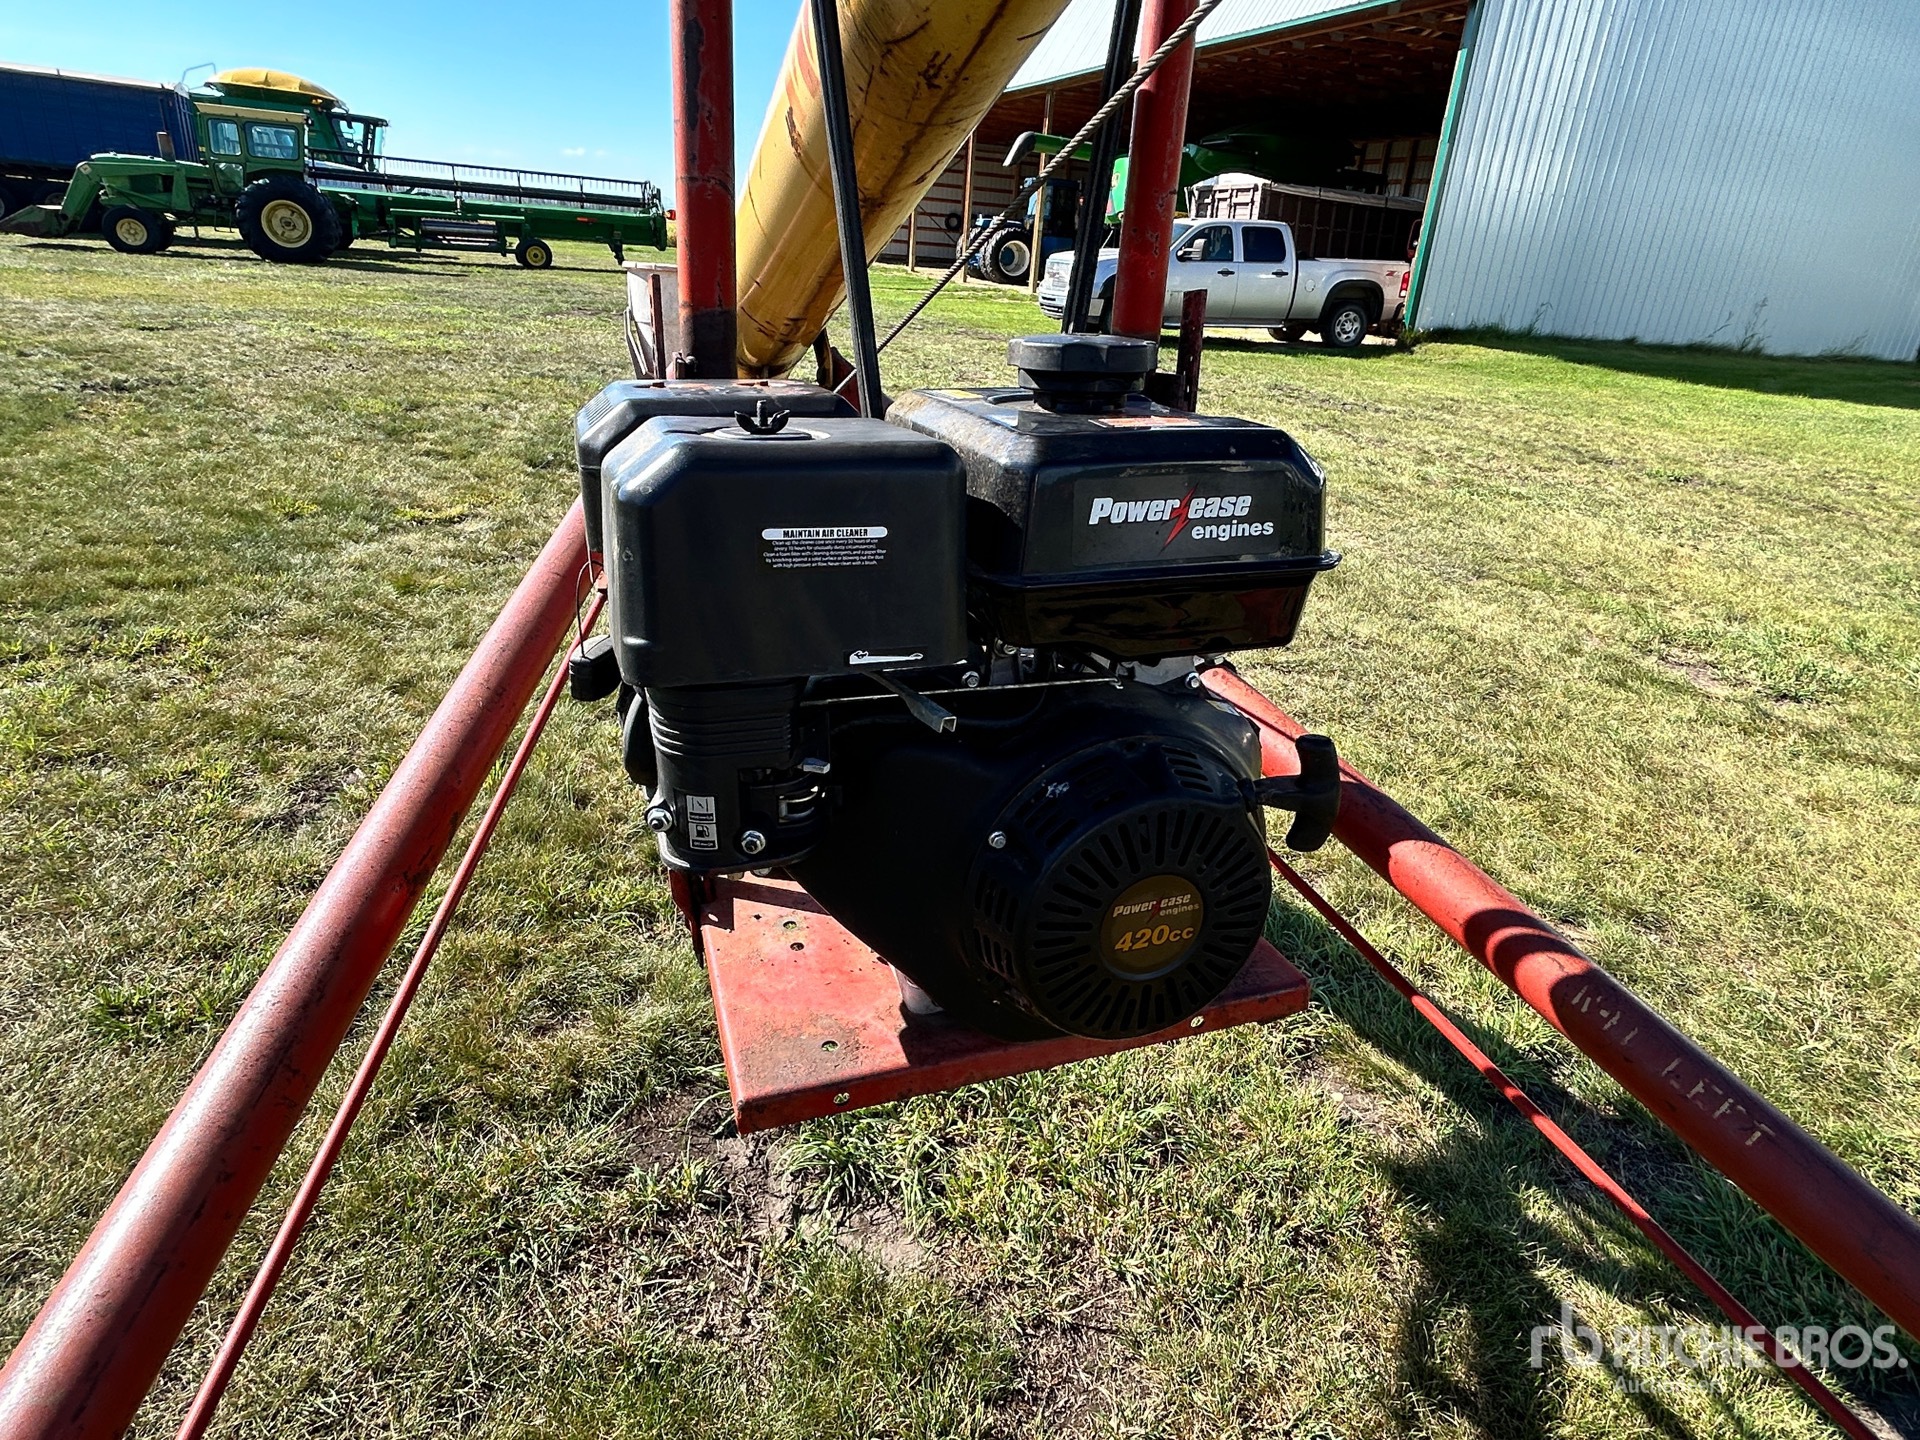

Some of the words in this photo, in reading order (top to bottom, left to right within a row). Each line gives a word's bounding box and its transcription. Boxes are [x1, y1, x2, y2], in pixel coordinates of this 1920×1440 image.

[783, 530, 820, 538] MAINTAIN
[822, 529, 834, 538] AIR
[1191, 519, 1274, 542] engines
[1159, 903, 1200, 916] engines
[1114, 924, 1194, 952] 420cc
